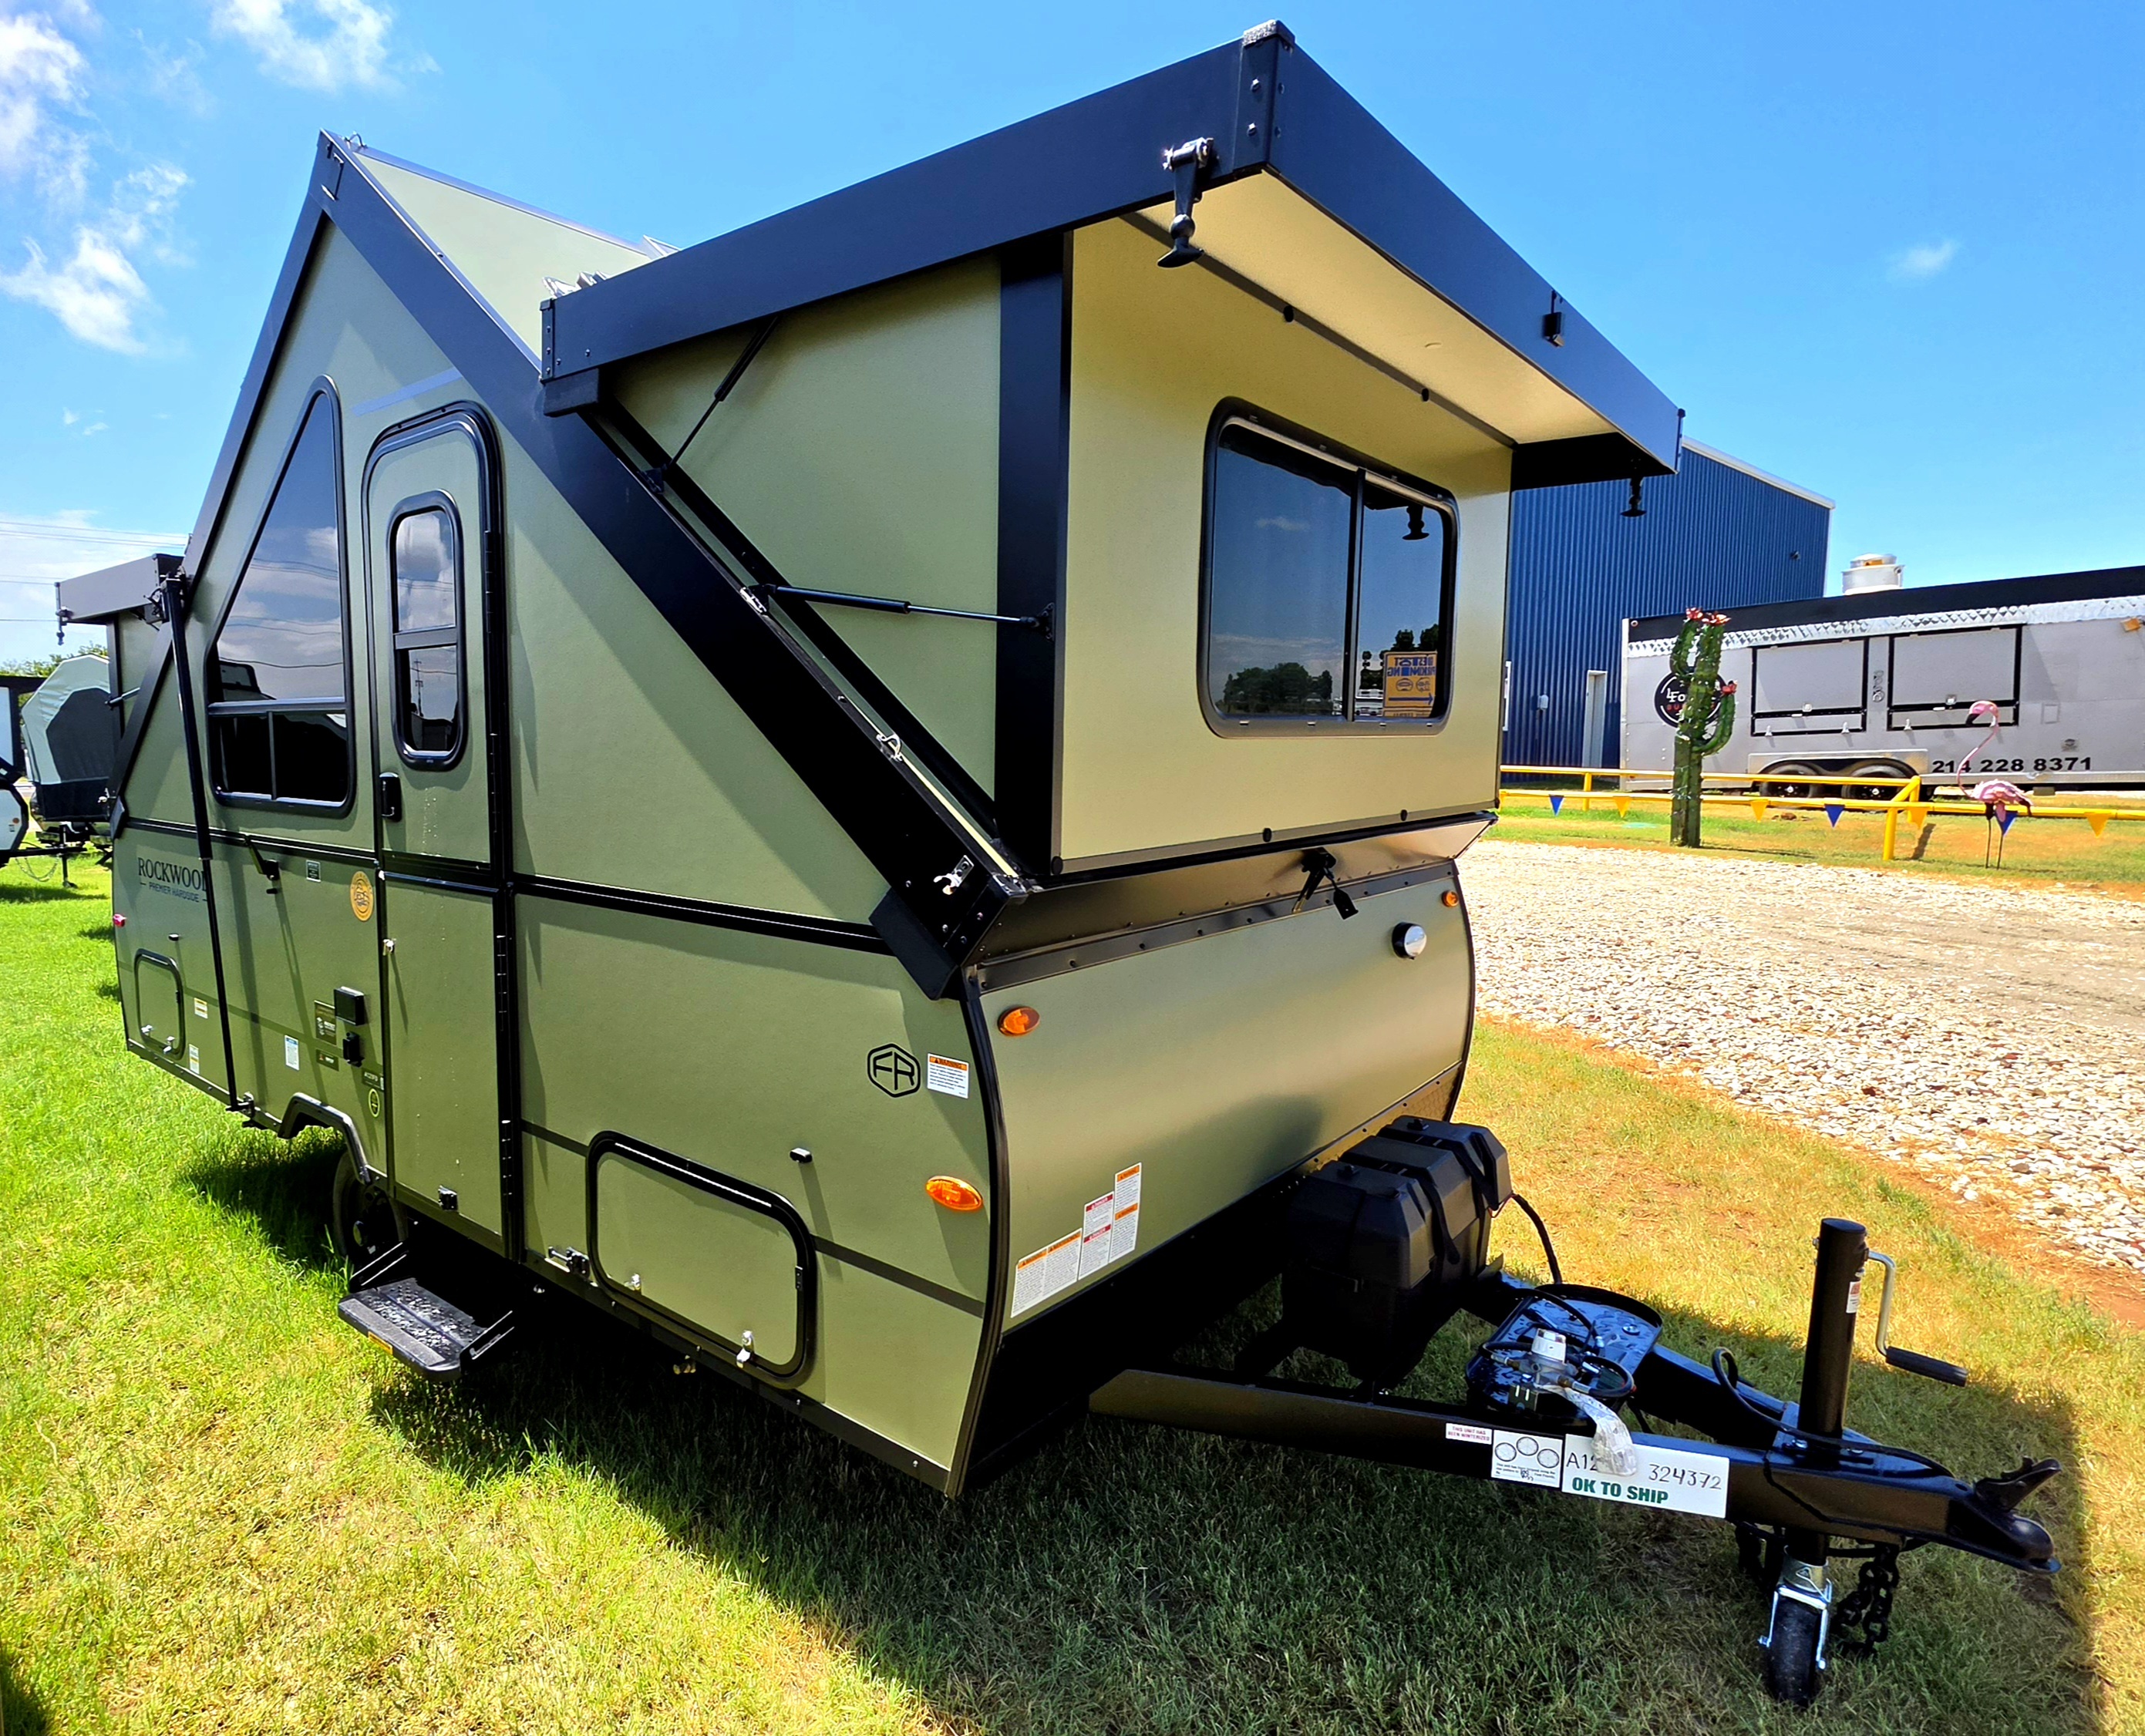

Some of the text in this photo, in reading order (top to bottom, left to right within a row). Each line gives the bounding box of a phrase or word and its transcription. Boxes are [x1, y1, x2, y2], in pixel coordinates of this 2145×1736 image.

[1932, 757, 2091, 773] 214 228 8371
[1572, 1476, 1669, 1504] OK TO SHIP
[1648, 1463, 1722, 1490] 324372
